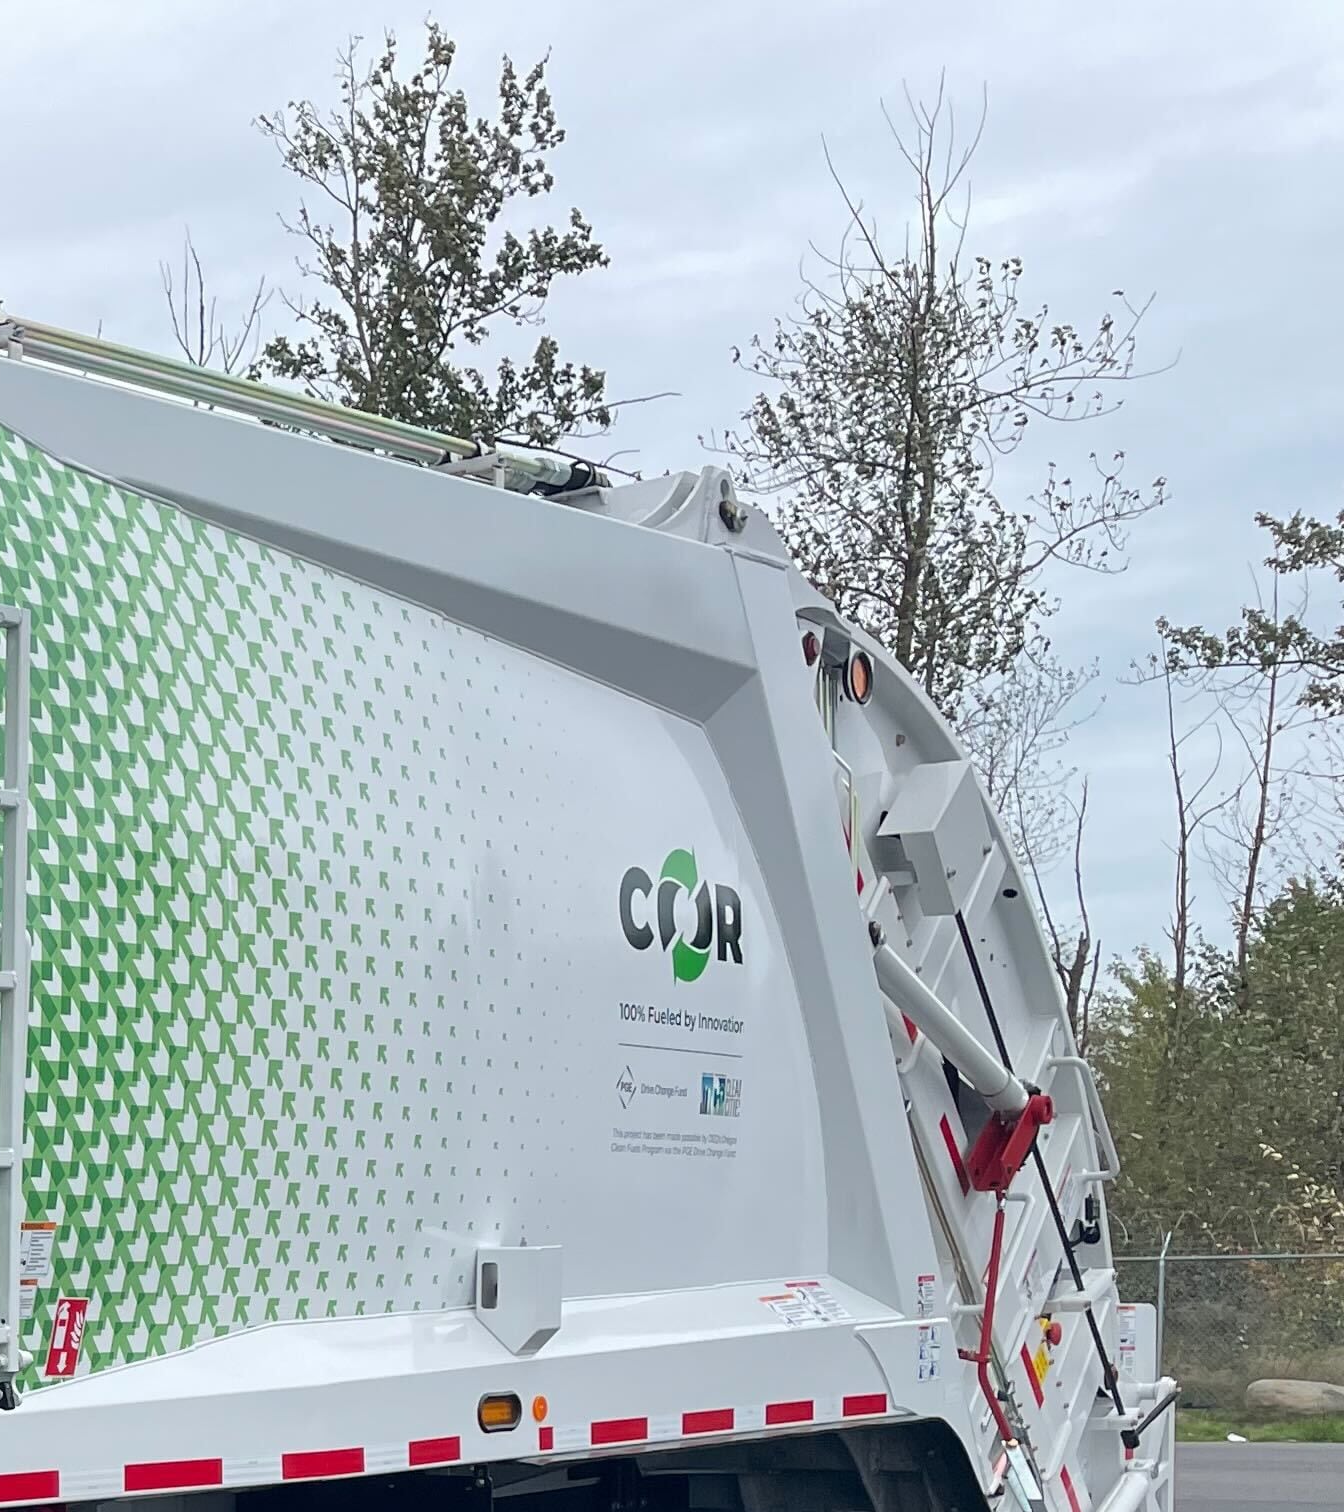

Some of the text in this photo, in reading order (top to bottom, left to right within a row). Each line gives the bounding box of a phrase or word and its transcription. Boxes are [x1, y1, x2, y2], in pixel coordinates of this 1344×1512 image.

[619, 866, 744, 966] COR
[619, 1002, 646, 1022] 100%
[648, 1006, 682, 1027] Fueled
[684, 1009, 697, 1032] by
